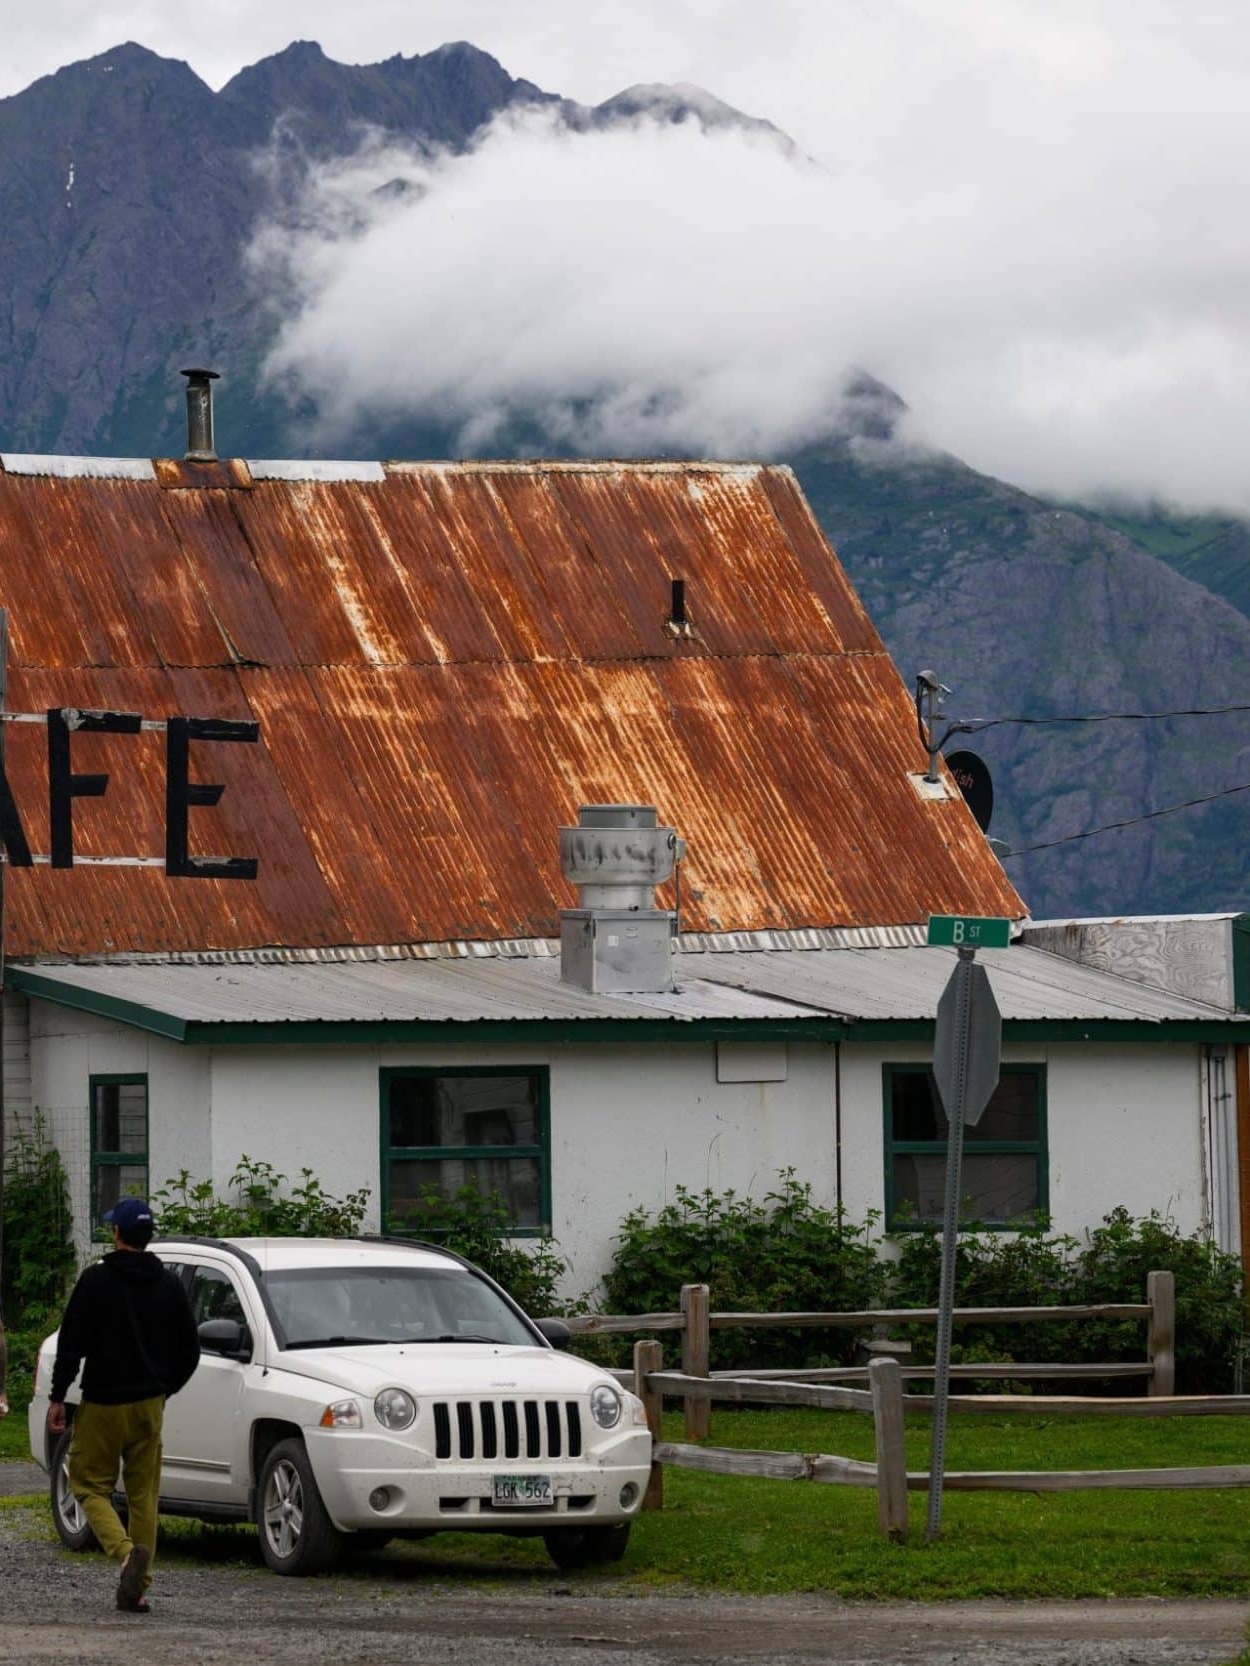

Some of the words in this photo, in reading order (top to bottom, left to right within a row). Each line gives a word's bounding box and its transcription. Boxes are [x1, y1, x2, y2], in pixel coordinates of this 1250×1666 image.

[953, 921, 965, 943] B
[969, 926, 981, 937] ST
[525, 1481, 550, 1498] 562
